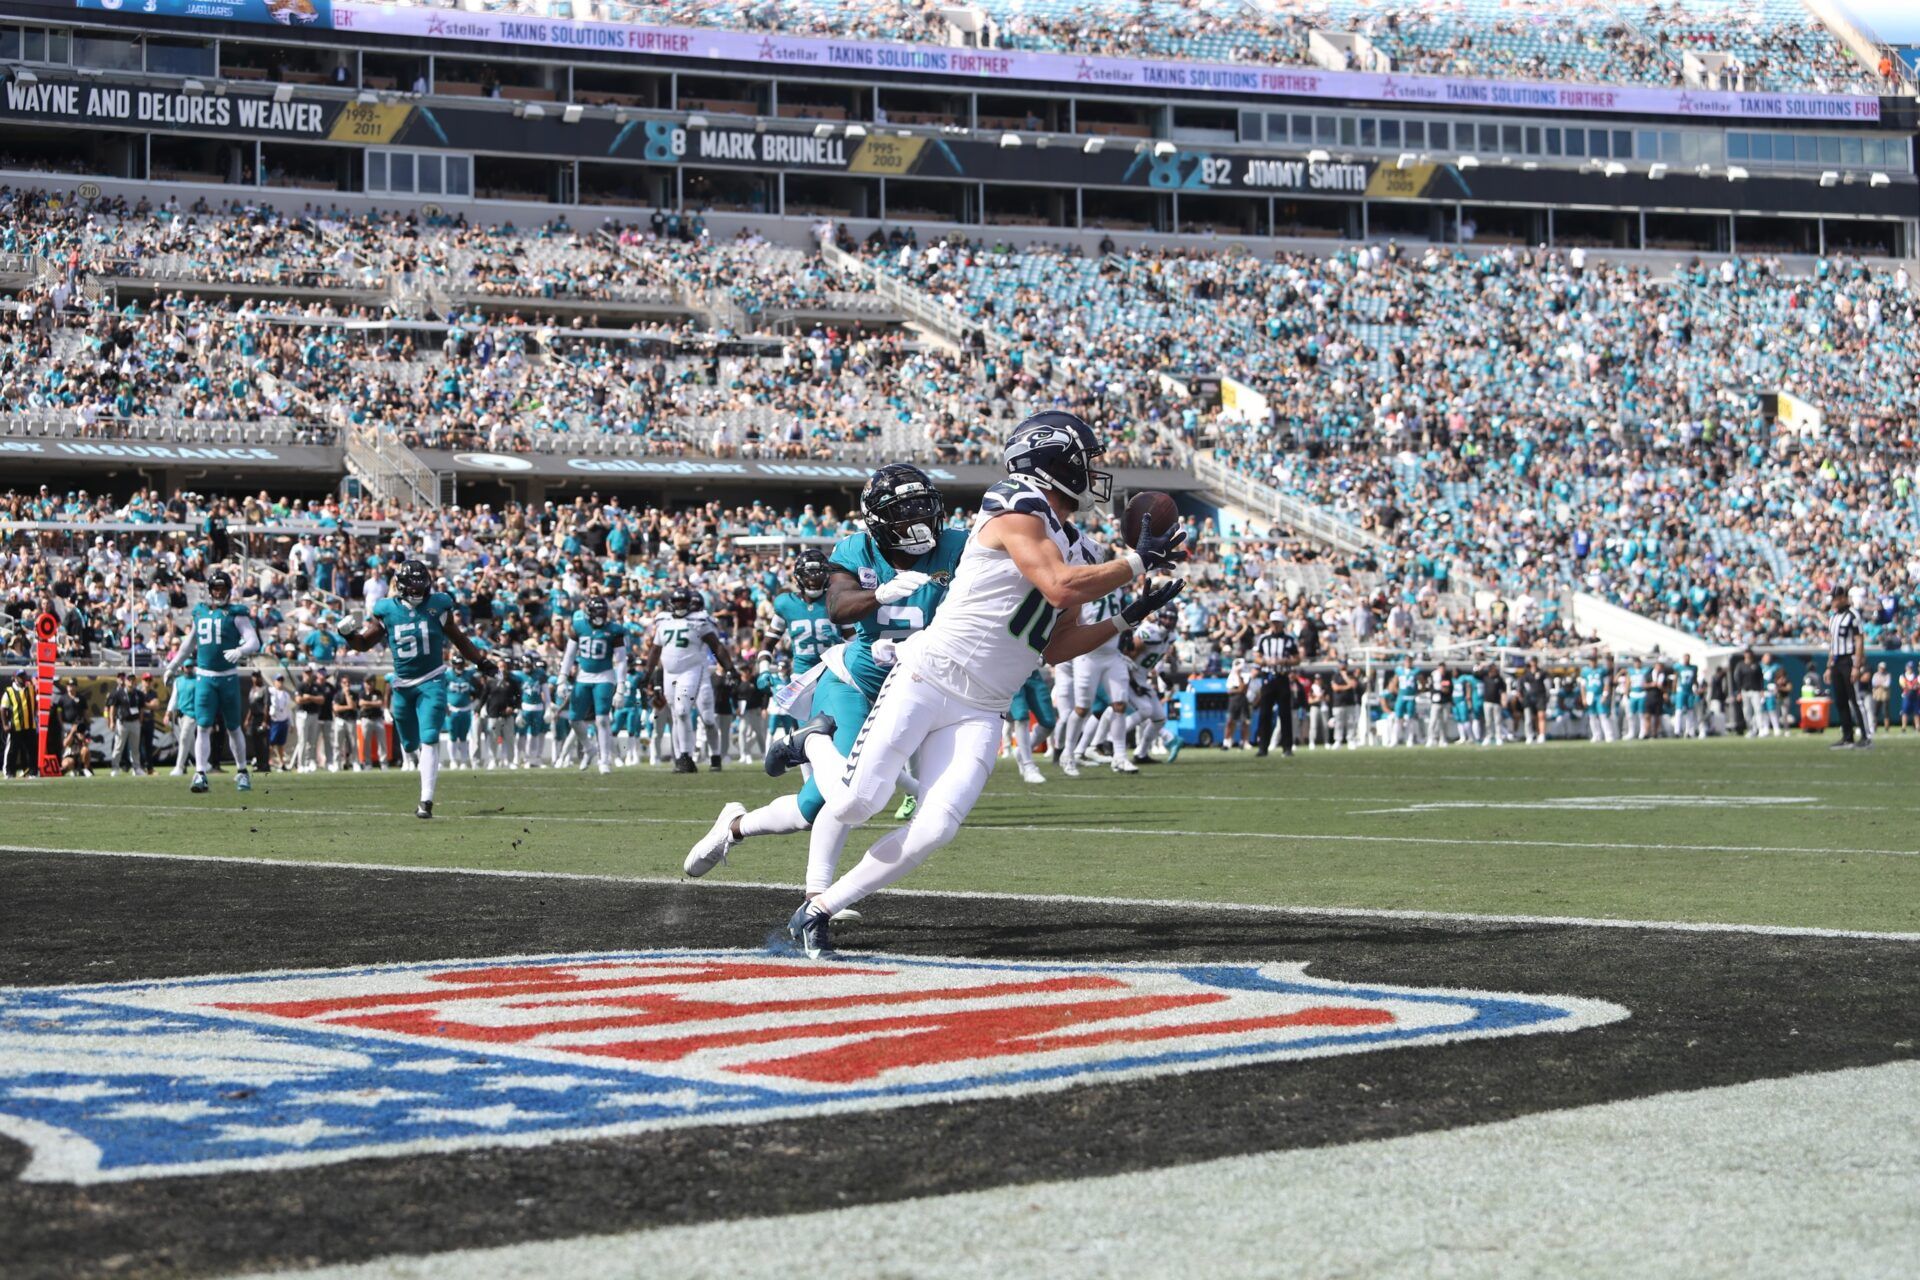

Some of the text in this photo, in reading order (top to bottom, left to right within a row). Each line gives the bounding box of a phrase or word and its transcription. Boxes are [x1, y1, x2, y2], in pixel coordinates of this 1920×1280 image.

[446, 21, 490, 37] stellar
[500, 22, 690, 51] TAKING SOLUTIONS FURTHER
[775, 47, 818, 61] stellar
[828, 46, 1009, 73] TAKING SOLUTIONS FURTHER
[1094, 69, 1133, 81] stellar
[1143, 67, 1317, 91] TAKING SOLUTIONS FURTHER
[1399, 86, 1437, 97] stellar
[1447, 84, 1614, 107] TAKING SOLUTIONS FURTHER
[7, 82, 323, 132] WAYNE AND DELORES WEAVER
[1693, 100, 1731, 111] stellar
[1740, 98, 1878, 117] TAKING SOLUTIONS FUR
[353, 122, 382, 136] 2011
[671, 128, 847, 165] 8 MARK BRUNELL
[1202, 158, 1366, 191] 82 JIMMY SMITH
[56, 442, 279, 460] INSURANCE
[567, 458, 747, 475] Gallagher
[197, 617, 222, 645] 91
[394, 620, 430, 658] 51
[663, 628, 690, 649] 75
[578, 635, 608, 660] 90
[44, 758, 61, 775] 20
